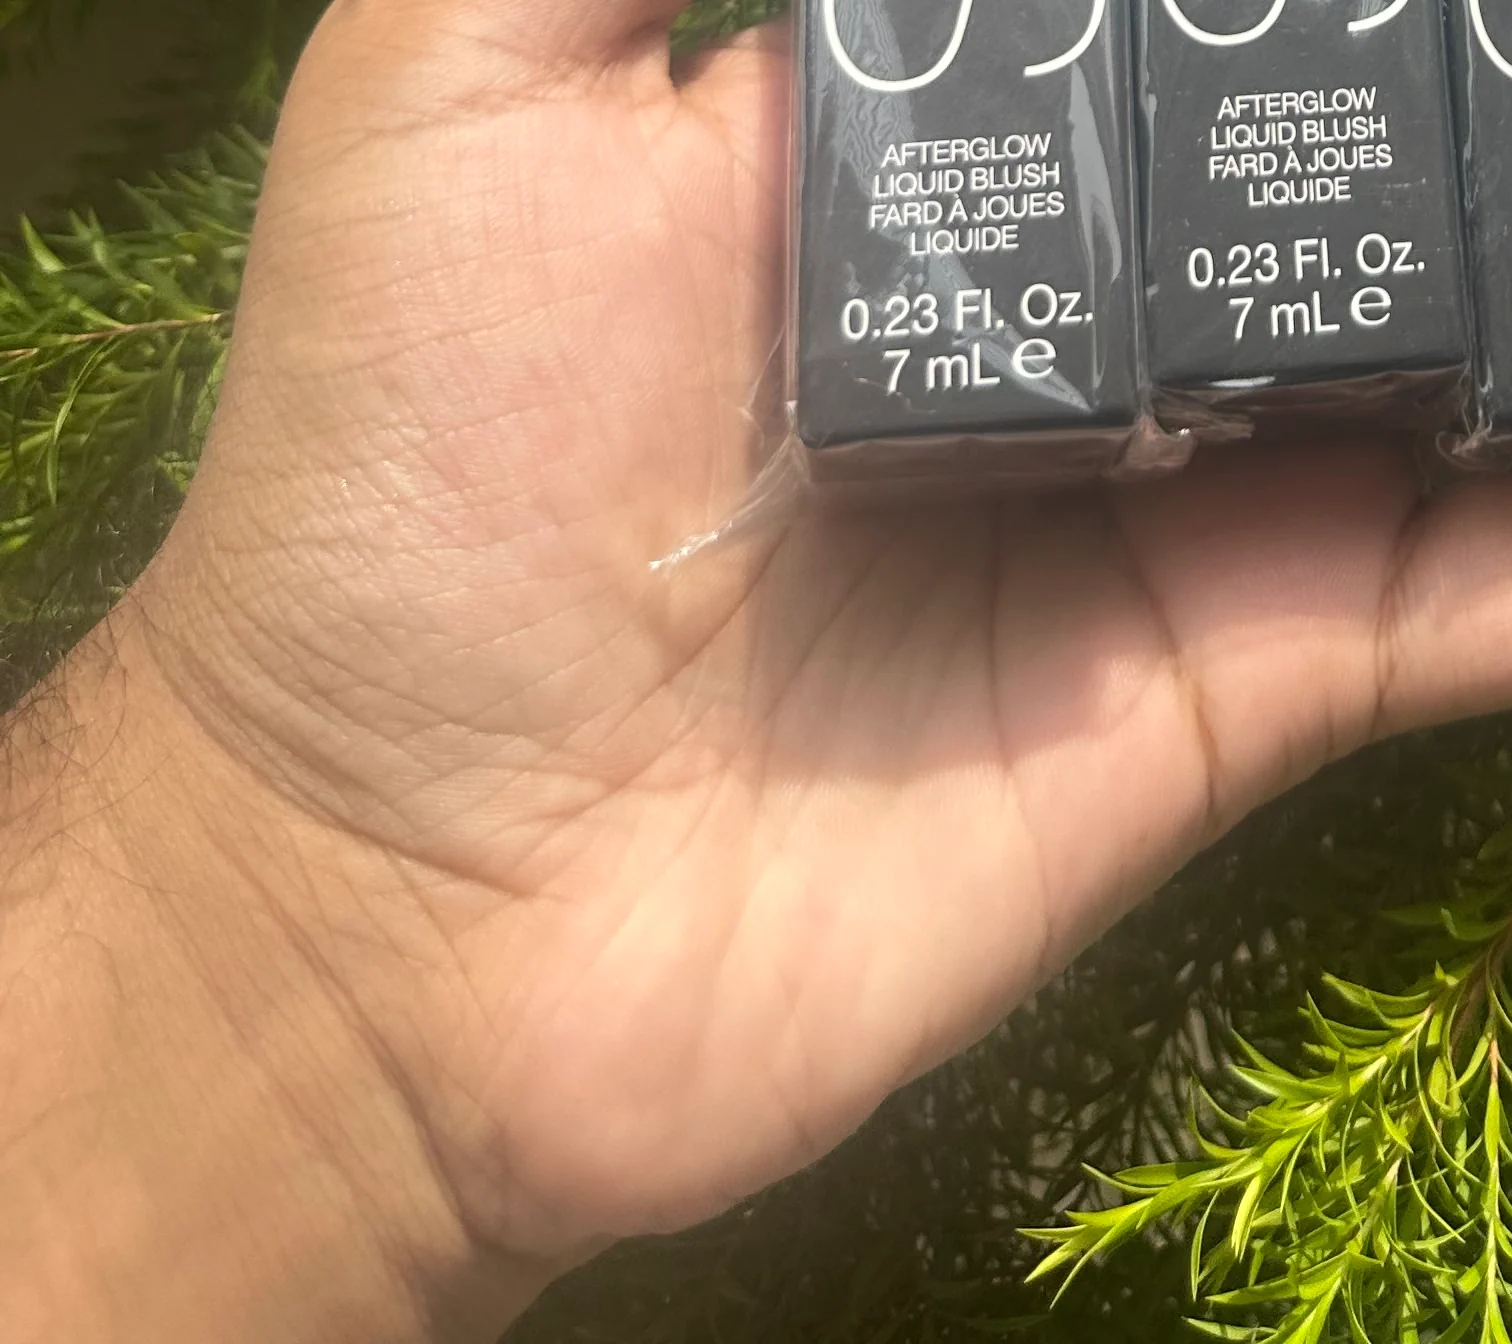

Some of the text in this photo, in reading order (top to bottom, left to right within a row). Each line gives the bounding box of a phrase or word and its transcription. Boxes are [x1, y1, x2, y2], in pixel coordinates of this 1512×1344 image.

[1218, 89, 1376, 120] AFTERGLOW
[882, 133, 1052, 168] AFTERGLOW
[1211, 117, 1388, 151] LIQUID BLUSH
[1208, 142, 1393, 181] FARD À JOUES
[872, 164, 1061, 199] LIQUID BLUSH
[1247, 178, 1352, 208] LIQUIDE
[869, 193, 1065, 230] FARD À JOUES
[909, 228, 1020, 257] LIQUIDE
[1187, 233, 1426, 289] 0.23 Fl. Oz.
[840, 283, 1093, 341] 0.23 Fl. Oz.
[1227, 297, 1254, 341] 7
[1270, 290, 1341, 336] mL
[883, 350, 909, 395] 7
[927, 344, 1001, 390] mL
